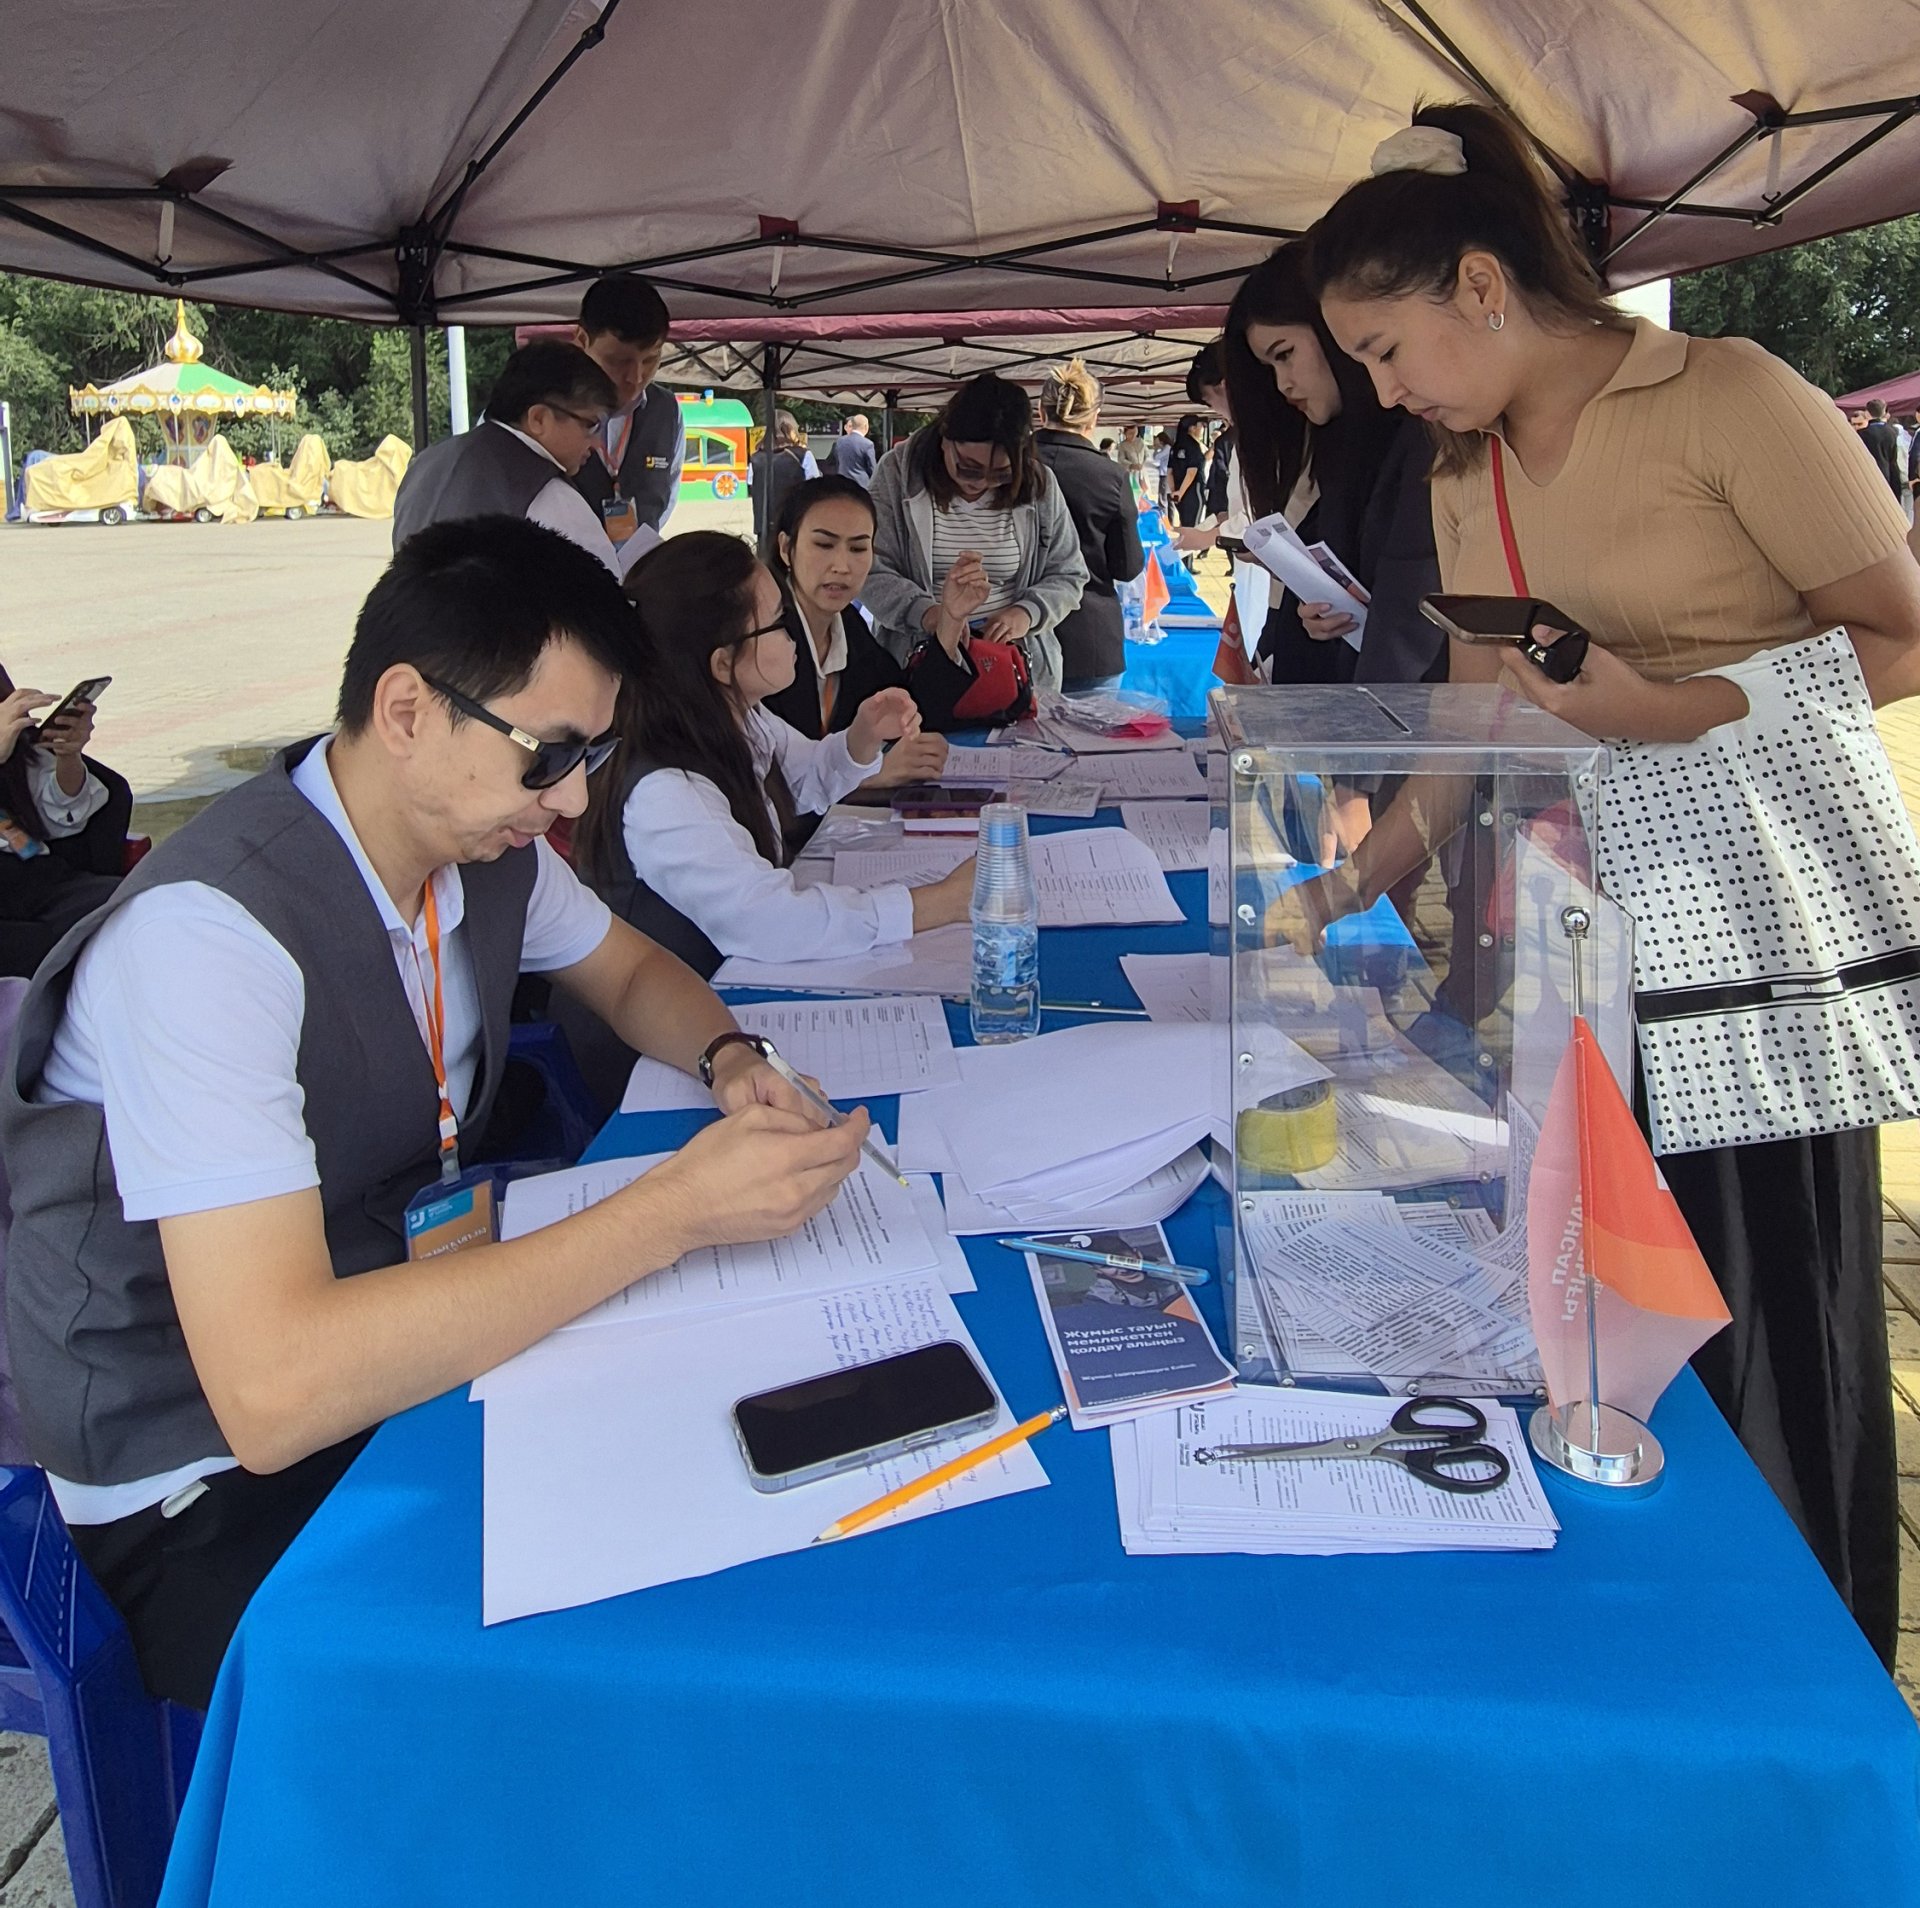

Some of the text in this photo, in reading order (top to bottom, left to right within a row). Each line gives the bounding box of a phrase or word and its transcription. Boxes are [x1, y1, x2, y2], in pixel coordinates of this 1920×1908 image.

[1064, 1321, 1179, 1339] Жұмыс тауып
[1067, 1330, 1174, 1346] мемлекеттен
[1070, 1336, 1186, 1355] қолдау алыңыз
